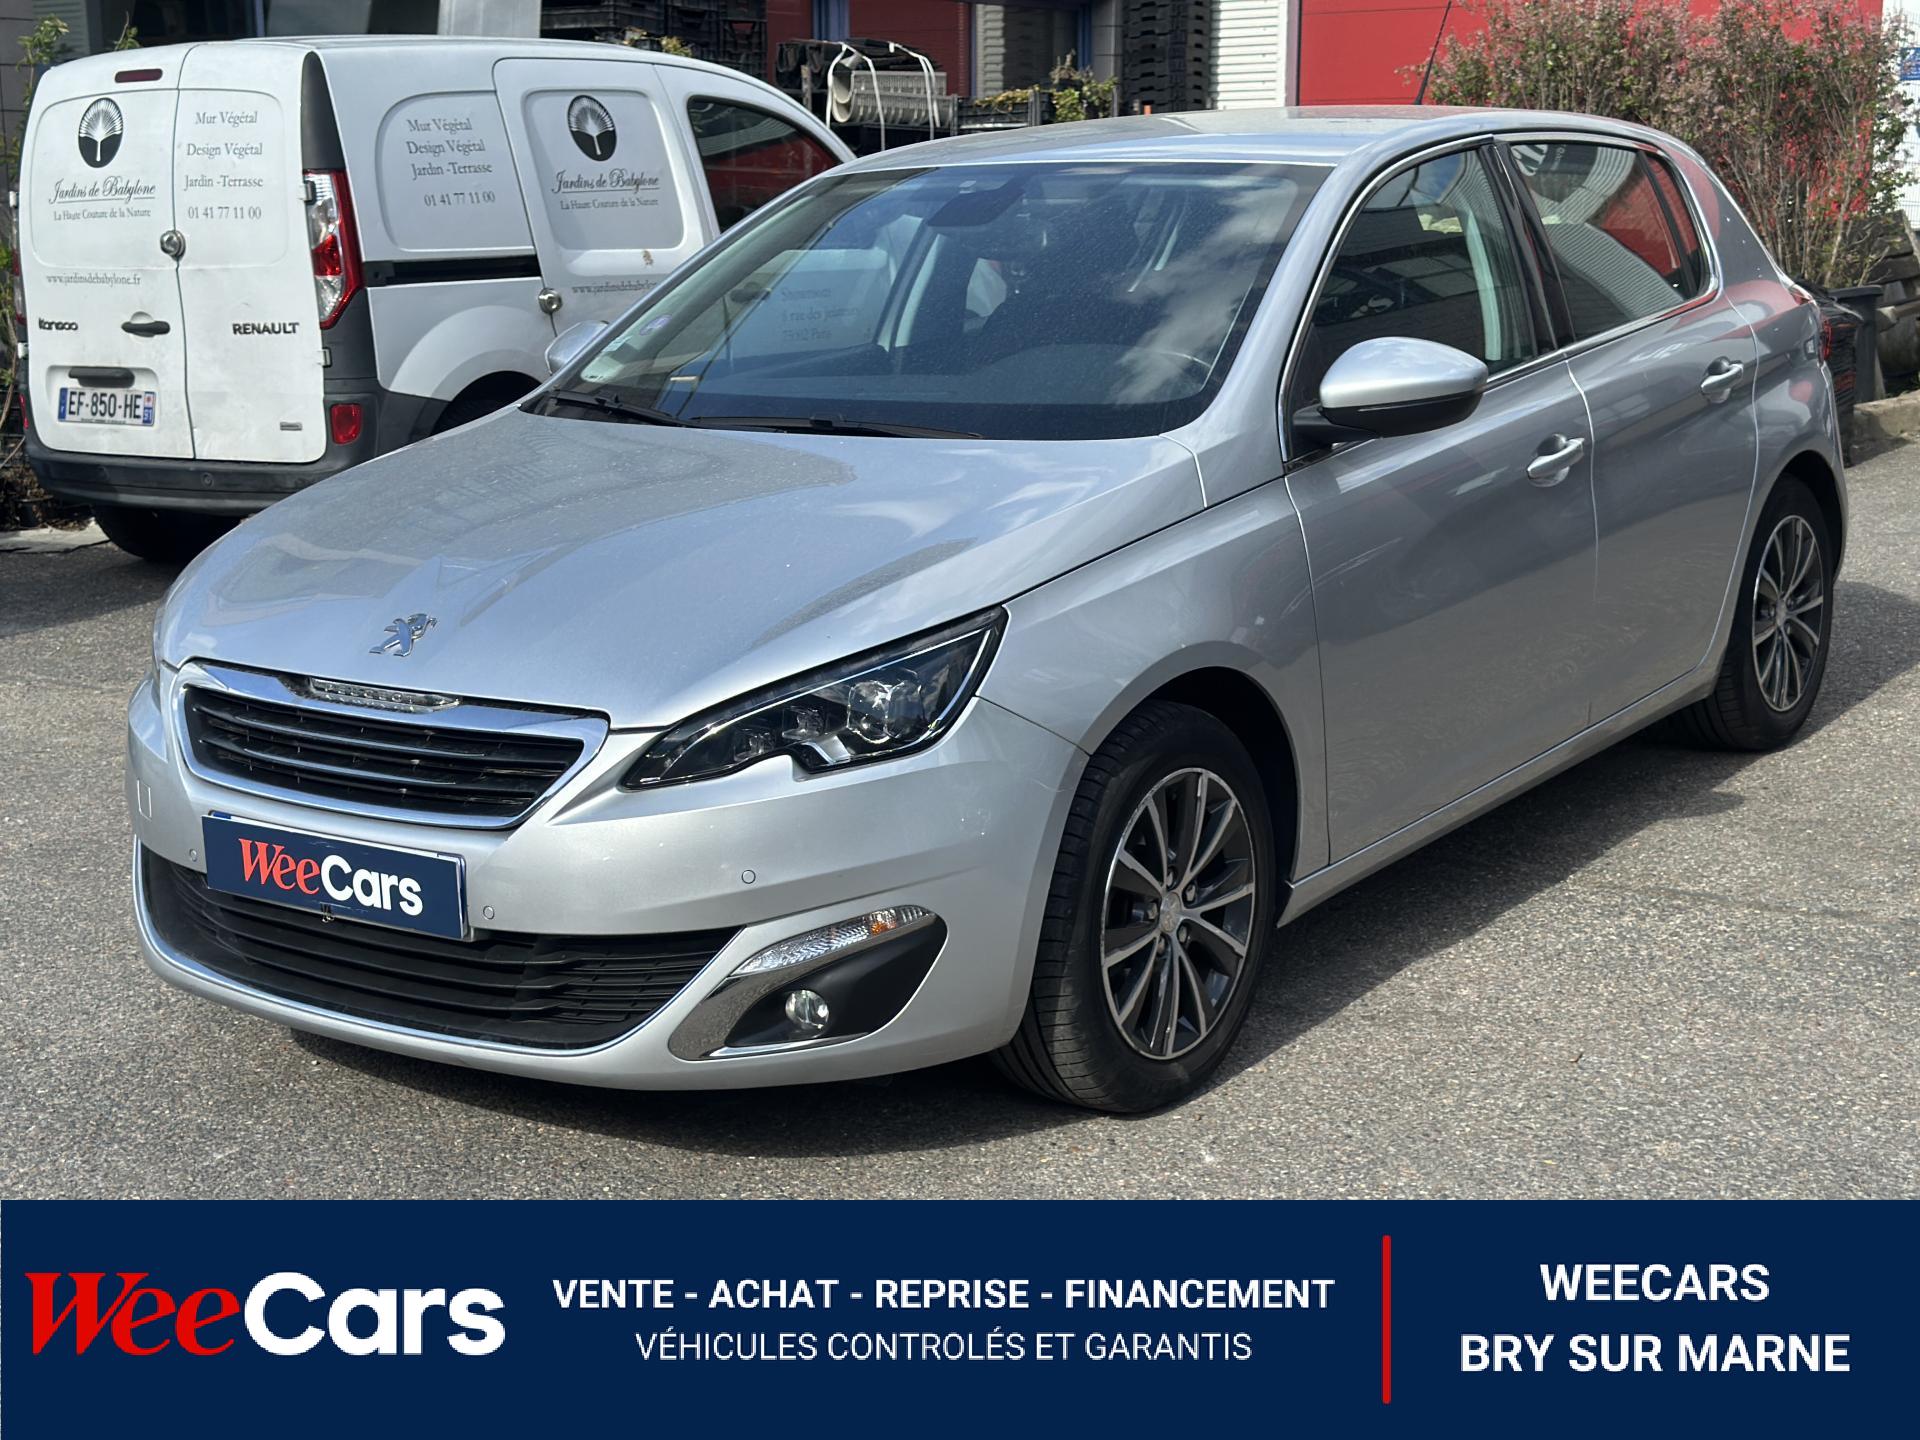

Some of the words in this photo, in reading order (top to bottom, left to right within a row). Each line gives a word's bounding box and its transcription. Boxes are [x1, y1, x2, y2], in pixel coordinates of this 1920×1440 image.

[195, 111, 217, 125] Mur
[219, 110, 258, 128] Végétal
[406, 119, 430, 132] Mur
[431, 118, 472, 135] Végétal
[186, 142, 221, 160] Design
[224, 142, 263, 160] Végétal
[406, 140, 445, 157] Design
[445, 139, 486, 156] Végétal
[411, 162, 445, 181] Jardin
[48, 178, 87, 204] Jardins
[88, 181, 99, 197] de
[102, 175, 156, 204] Babylone
[183, 175, 214, 192] Jardin
[551, 169, 594, 194] Jardins
[595, 172, 607, 188] de
[608, 168, 659, 194] Babylone
[424, 194, 437, 207] 01
[440, 193, 452, 206] 41
[482, 190, 496, 203] 00
[54, 211, 62, 221] La
[63, 210, 81, 221] Haute
[82, 208, 108, 219] Couture
[109, 208, 117, 218] de
[118, 207, 126, 217] la
[127, 207, 151, 217] Nature
[187, 206, 199, 219] 01
[202, 206, 214, 219] 41
[217, 206, 230, 219] 77
[233, 206, 244, 219] 11
[248, 205, 262, 220] 00
[46, 272, 140, 287] www.jardinsdebabylone.fr
[232, 322, 300, 335] RENAULT
[68, 391, 142, 419] EF-850-HE
[238, 838, 424, 916] WeeCars
